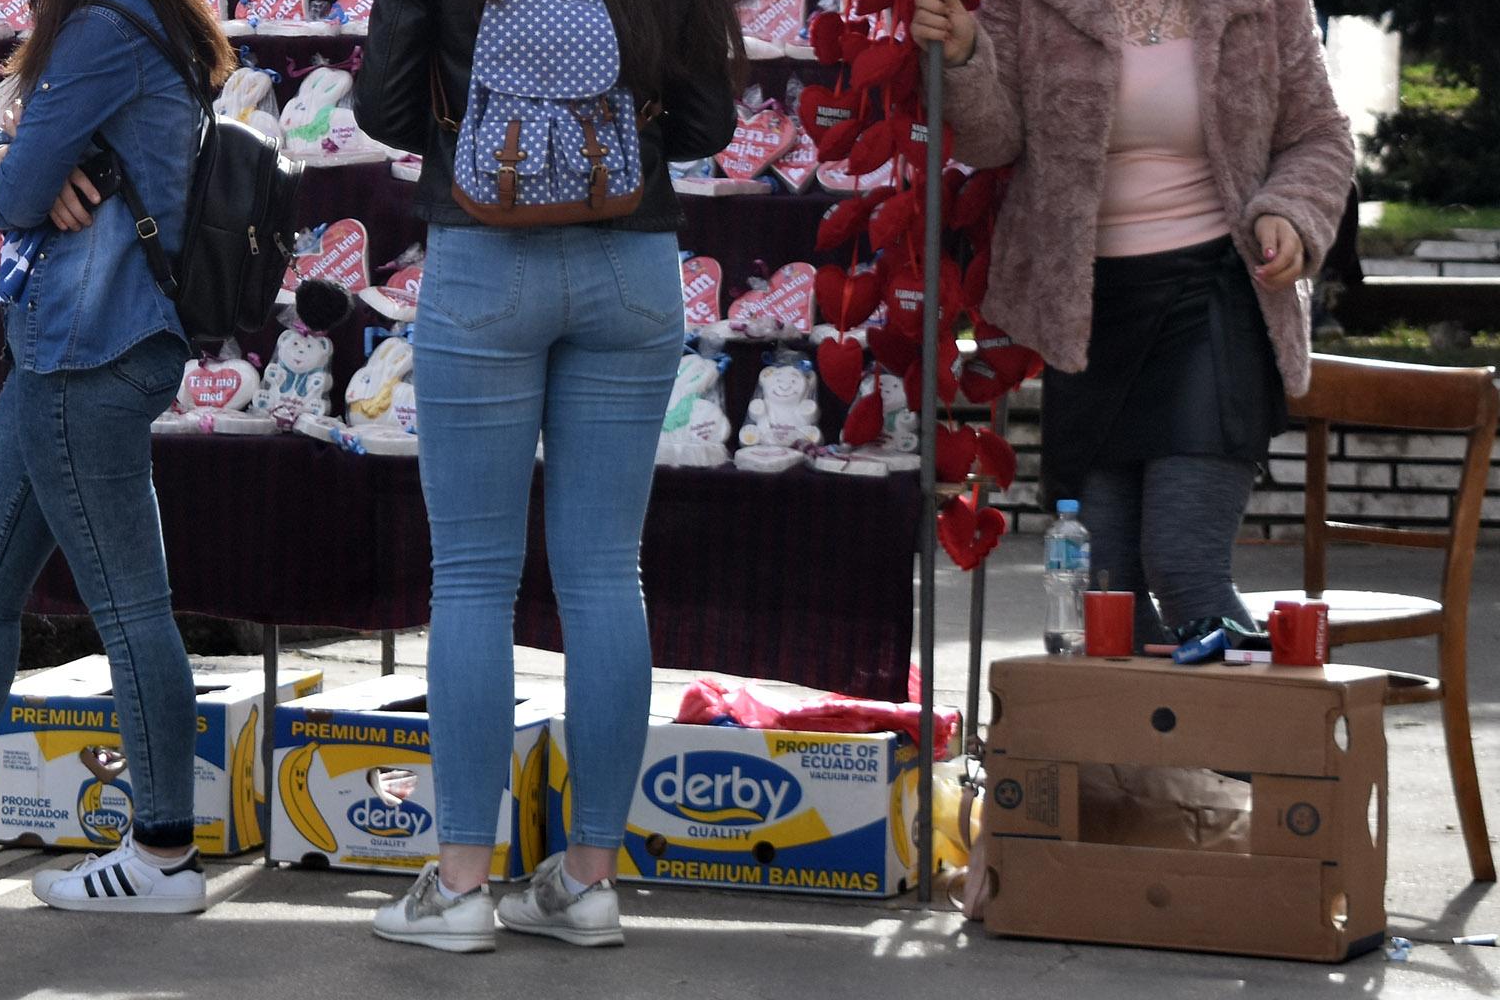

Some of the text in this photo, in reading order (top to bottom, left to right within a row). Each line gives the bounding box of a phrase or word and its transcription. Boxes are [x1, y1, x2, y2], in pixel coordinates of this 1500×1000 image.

[189, 374, 238, 390] Ti si moj
[199, 390, 225, 402] med
[10, 706, 105, 728] PREMIUM
[291, 721, 388, 743] PREMIUM
[775, 739, 880, 758] PRODUCE OF
[800, 757, 879, 773] ECUADOR
[809, 770, 878, 784] VACUUM PACK
[653, 752, 791, 824] derby
[1, 795, 52, 808] PRODUCE
[1, 806, 69, 820] OF ECUADOR
[85, 809, 127, 829] derby
[352, 797, 427, 837] derby
[1, 817, 56, 829] VACUUM PACK
[687, 824, 752, 841] QUALITY
[370, 837, 406, 849] QUALITY
[655, 859, 879, 893] PREMIUM BANANAS
